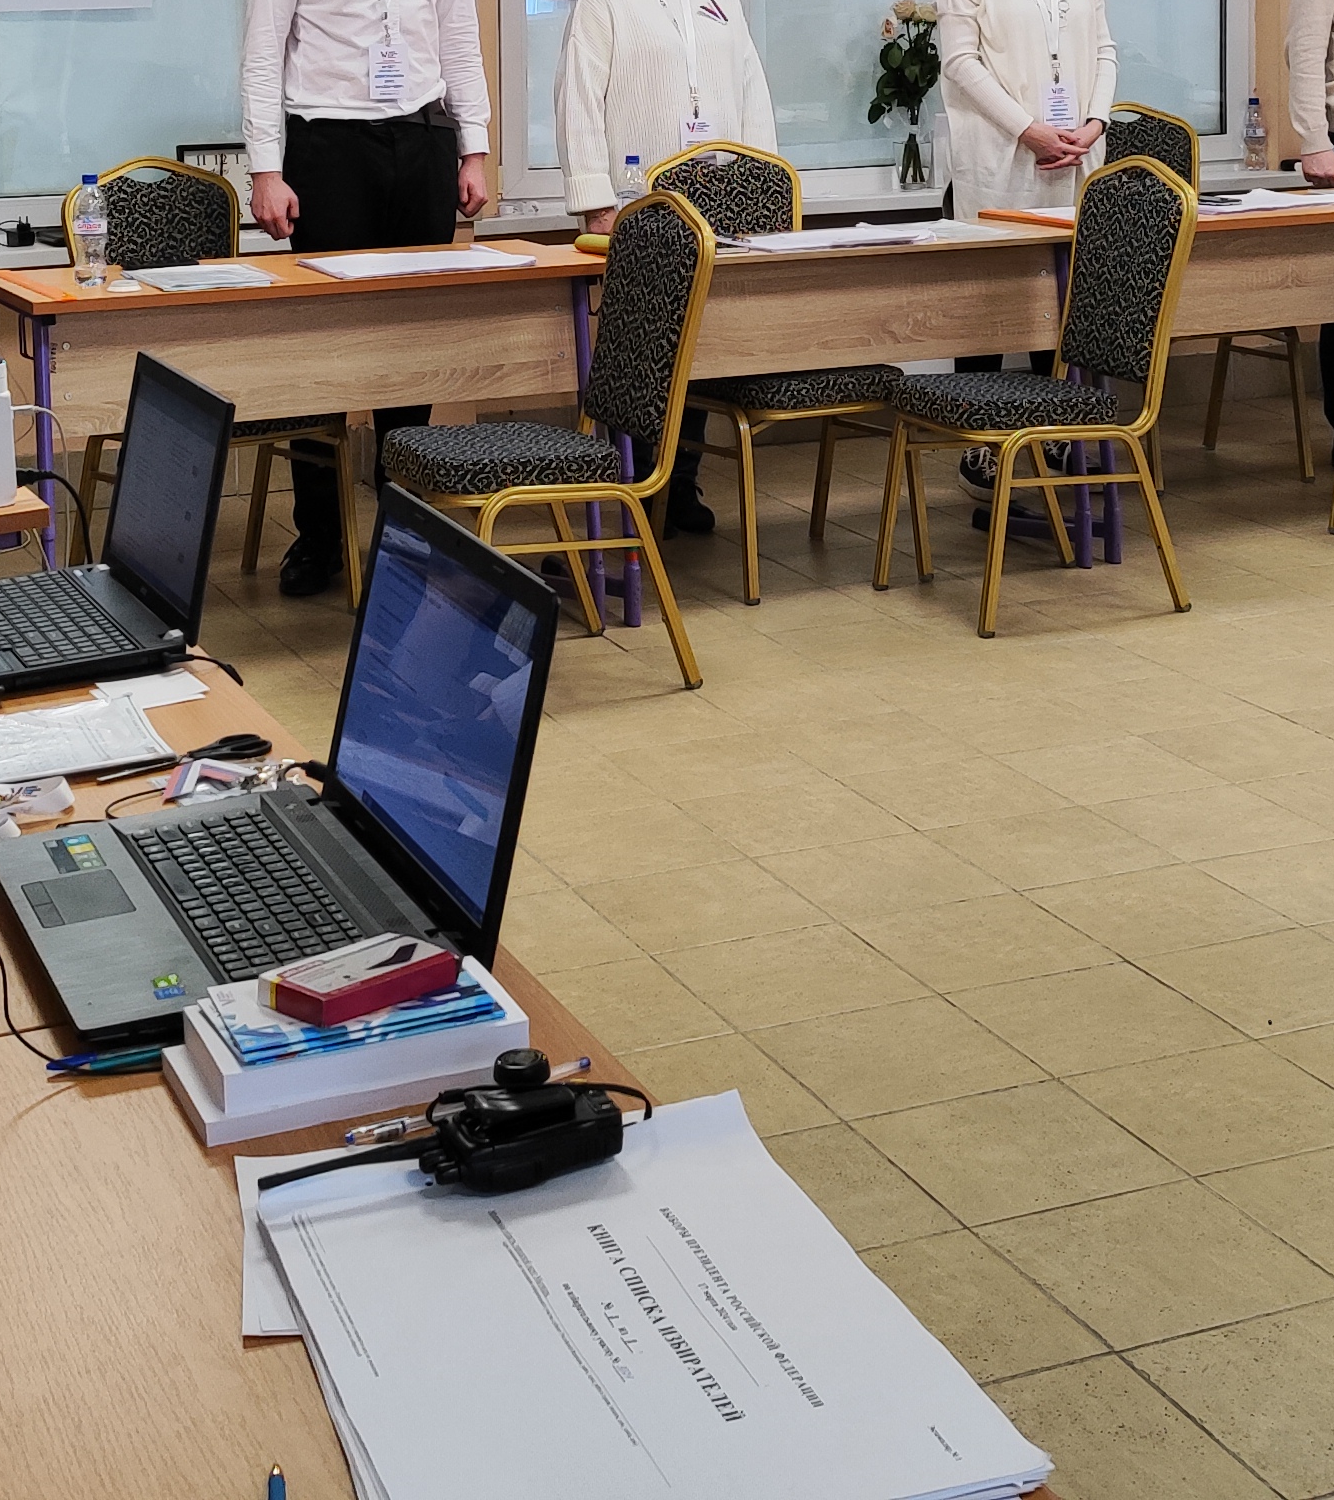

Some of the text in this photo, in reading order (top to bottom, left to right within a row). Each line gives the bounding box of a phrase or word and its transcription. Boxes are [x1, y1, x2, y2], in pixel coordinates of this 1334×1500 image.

[586, 1223, 626, 1266] КНИГА
[619, 1266, 667, 1325] СПИСКА
[657, 1324, 747, 1423] ИЗБИРАТЕЛЕЙ
[659, 1206, 825, 1408] ВЫБОРЫ ПРЕЗИДЕНТА РОССИЙСКОЙ ФЕДЕРАЦИИ
